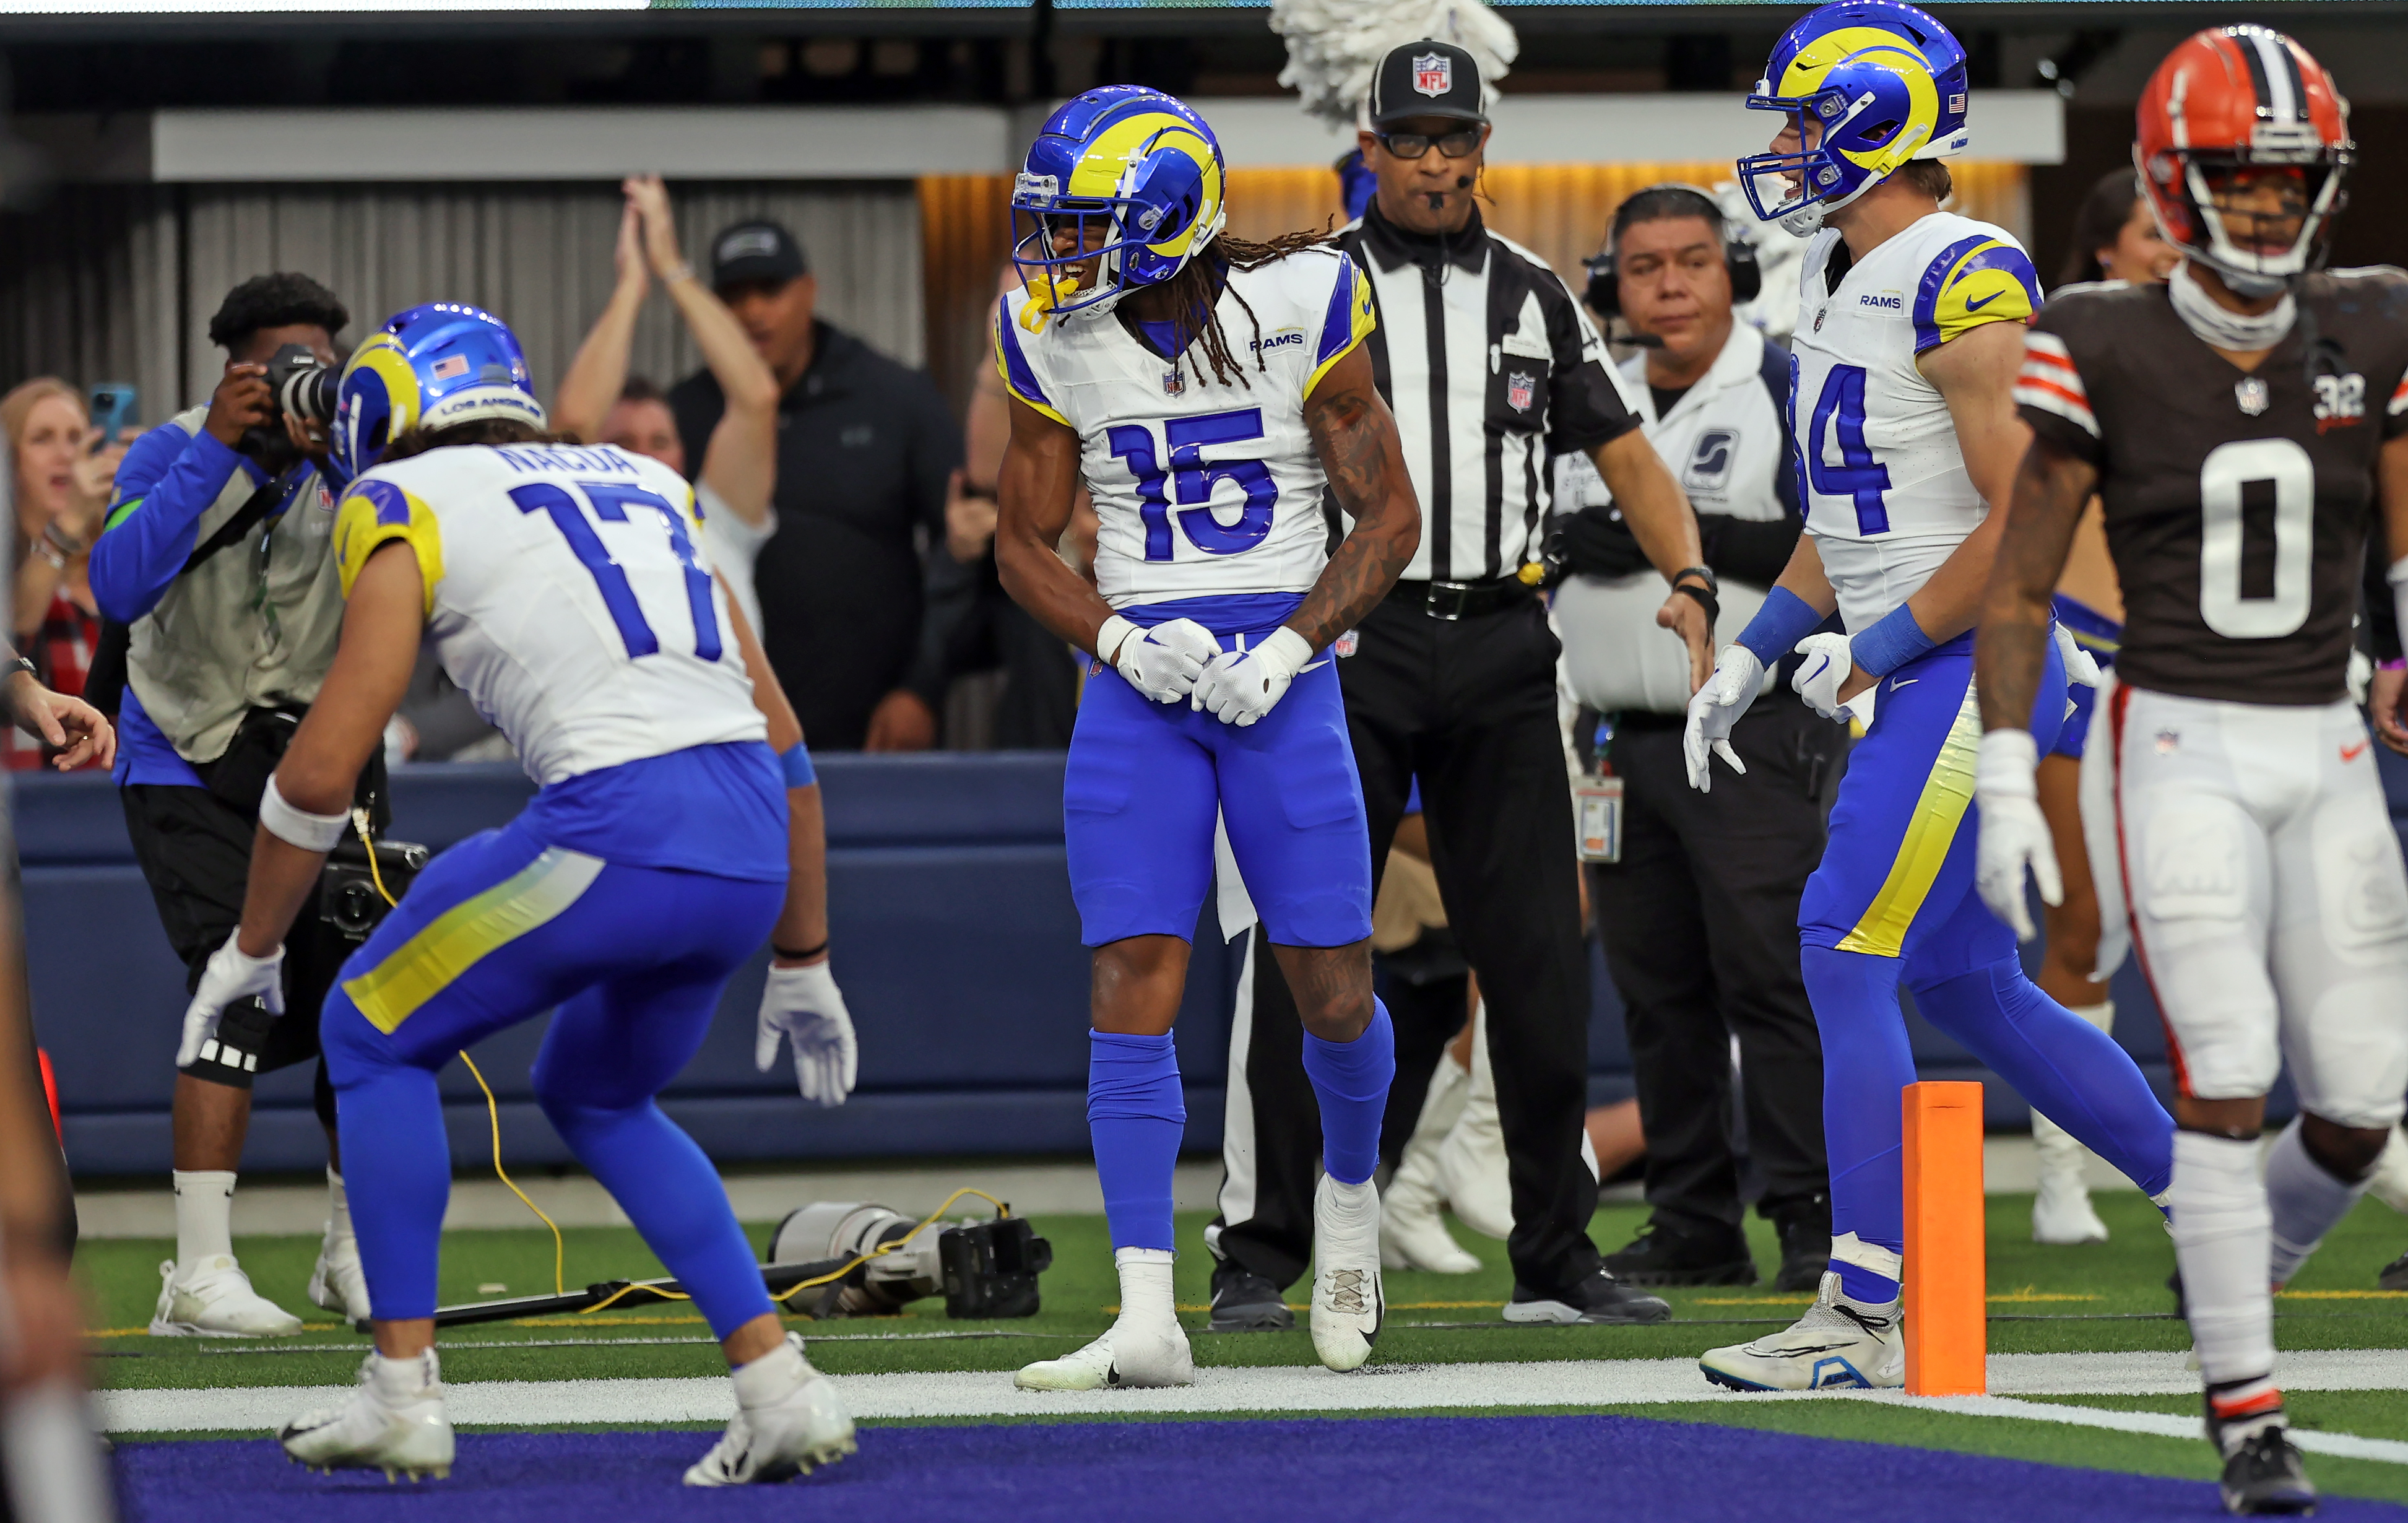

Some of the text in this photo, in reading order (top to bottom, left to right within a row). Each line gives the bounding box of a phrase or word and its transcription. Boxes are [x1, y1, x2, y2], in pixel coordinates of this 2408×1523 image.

[1418, 72, 1447, 90] NFL
[1860, 295, 1901, 309] RAMS
[1249, 334, 1303, 351] RAMS
[2312, 373, 2366, 420] 32
[495, 448, 641, 475] NACUA
[1787, 353, 1892, 537] 4
[1106, 407, 1279, 562] 15
[2199, 437, 2315, 640] 0
[506, 479, 723, 662] 17
